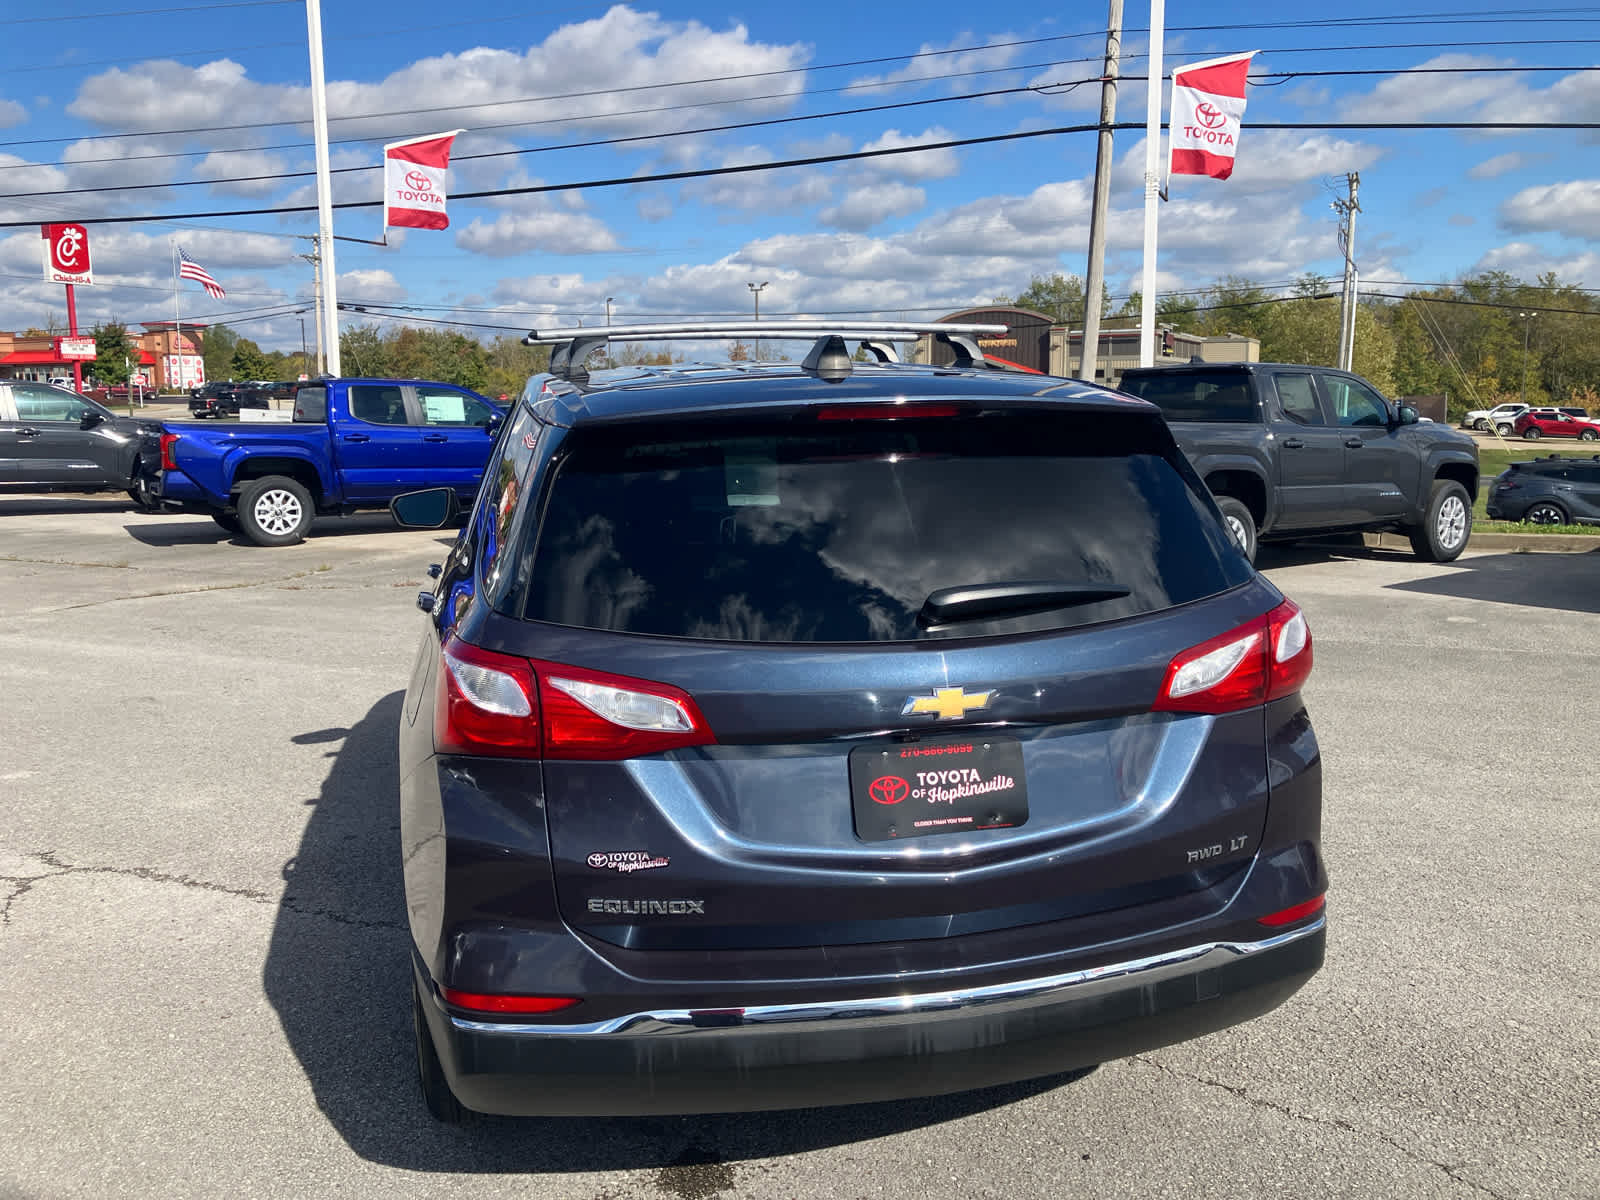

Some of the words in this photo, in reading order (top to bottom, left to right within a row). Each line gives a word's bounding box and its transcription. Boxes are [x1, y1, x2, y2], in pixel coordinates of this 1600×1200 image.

[1183, 126, 1234, 146] TOYOTA
[396, 190, 443, 203] TOYOTA
[916, 768, 981, 786] TOYOTA
[912, 789, 927, 799] OF
[928, 775, 1015, 804] Hopkinsville
[1230, 835, 1248, 852] LT
[607, 861, 618, 869] OF
[618, 857, 669, 872] Hopkinsville
[608, 852, 649, 861] TOYOTA
[587, 898, 704, 914] EQUINOX
